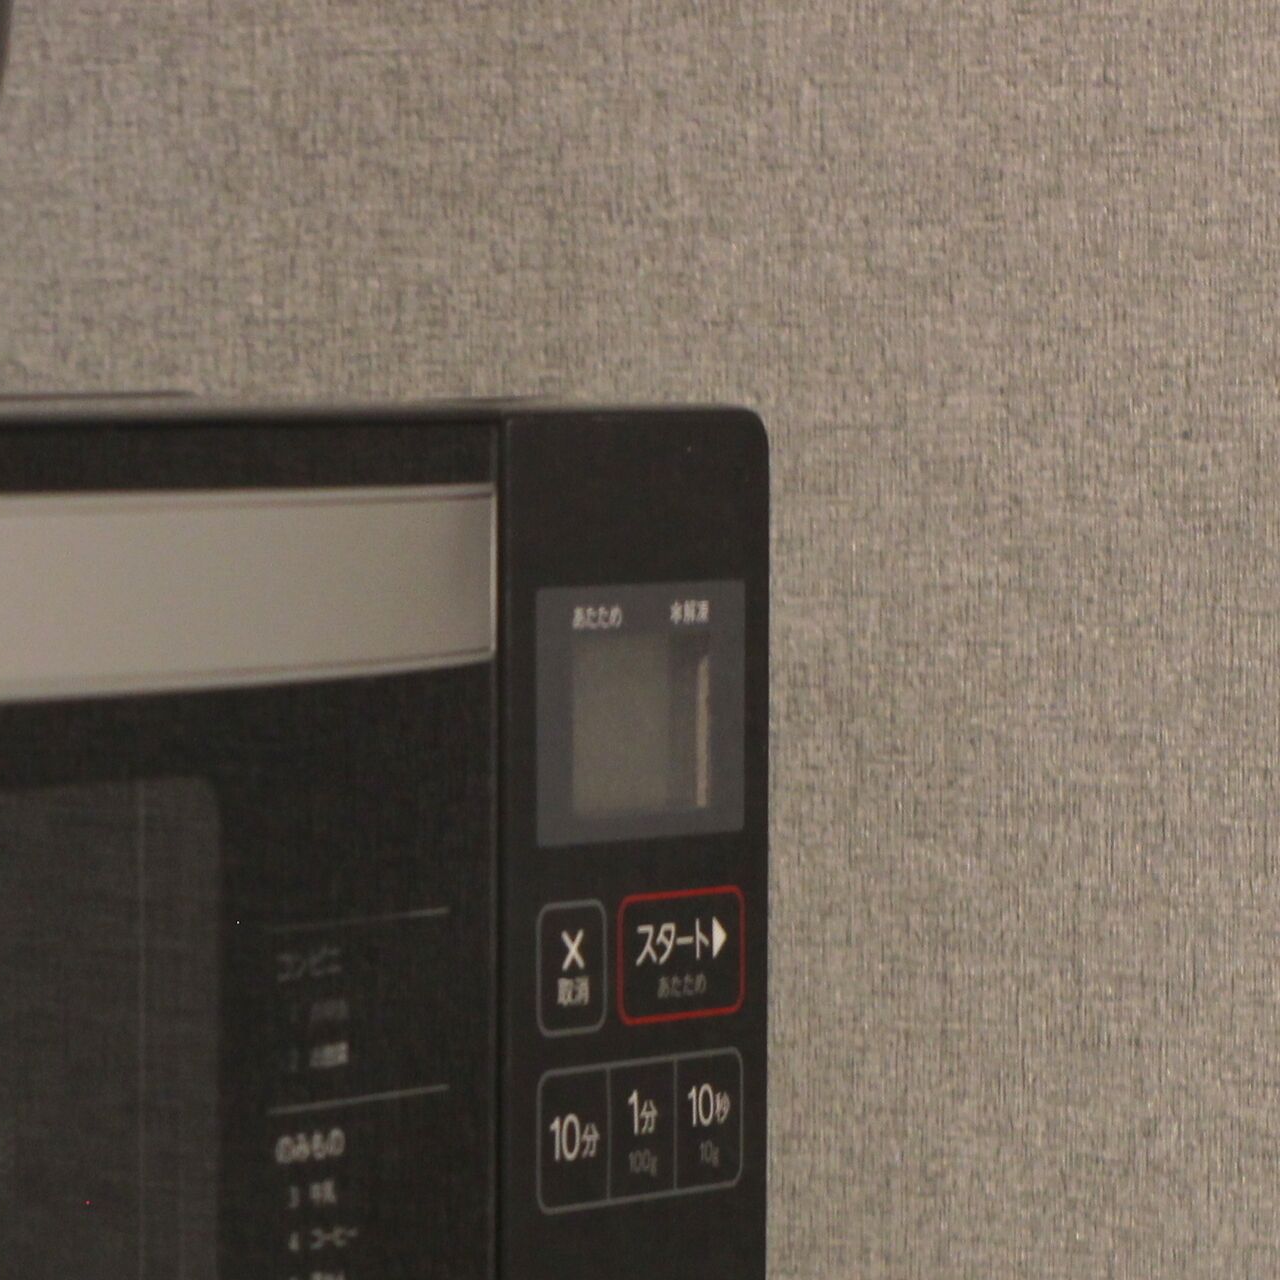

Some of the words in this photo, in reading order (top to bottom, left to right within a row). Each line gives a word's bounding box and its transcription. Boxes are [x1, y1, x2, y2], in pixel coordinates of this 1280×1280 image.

[636, 916, 710, 967] スタート
[657, 971, 708, 999] あたため
[549, 1113, 601, 1162] 10分
